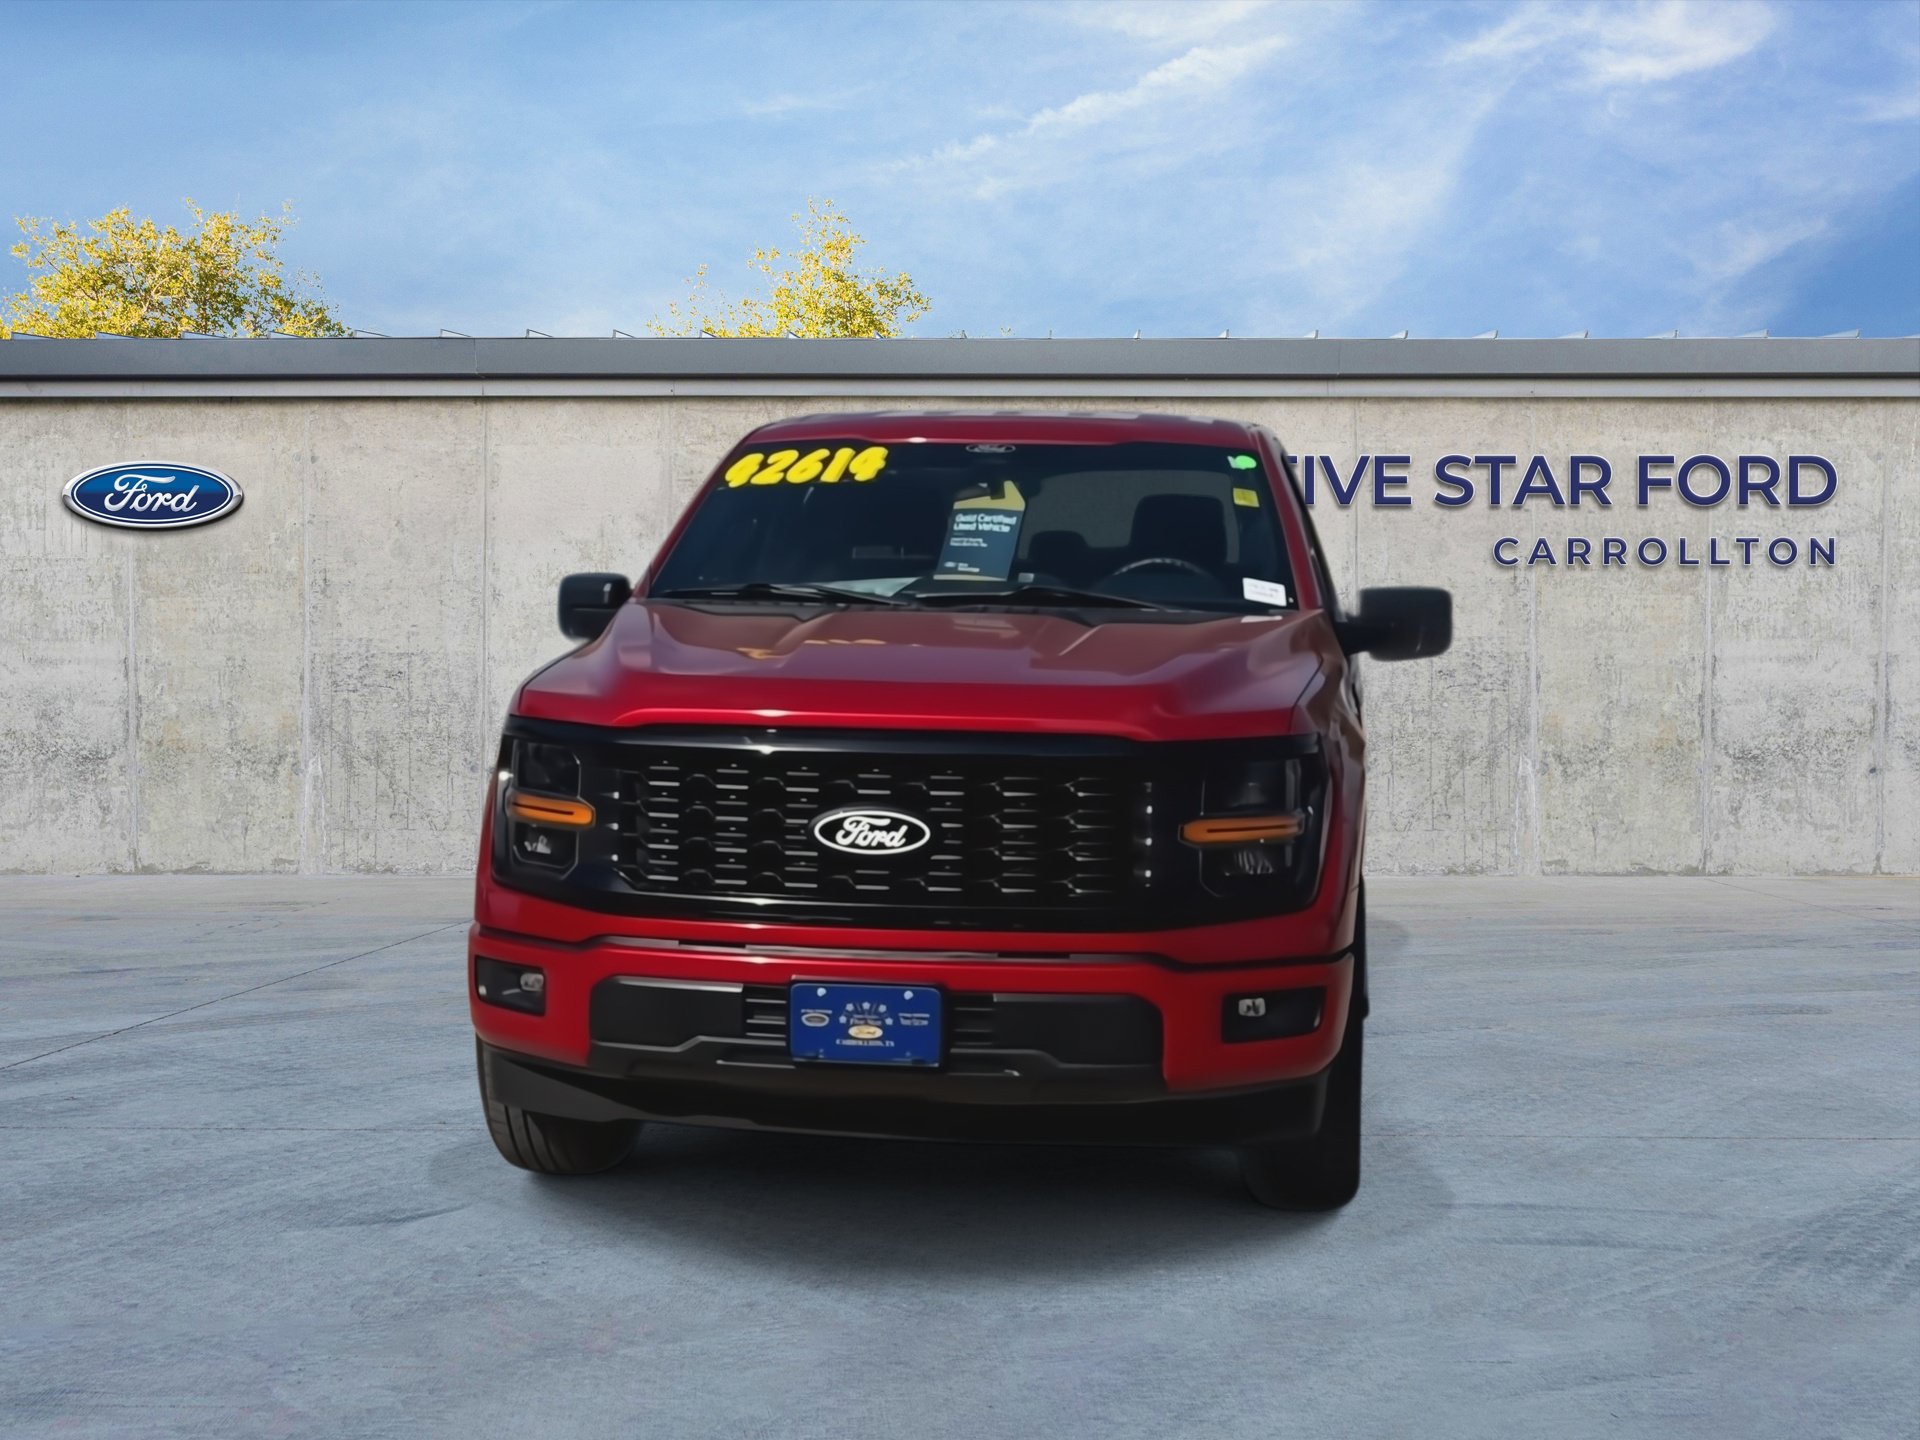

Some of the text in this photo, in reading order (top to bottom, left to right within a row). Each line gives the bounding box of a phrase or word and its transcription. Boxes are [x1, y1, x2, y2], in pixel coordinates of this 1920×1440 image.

[724, 446, 889, 488] 42614
[1287, 454, 1839, 507] IVE STAR FORD
[103, 473, 200, 513] Ford
[953, 522, 1011, 533] Used Vehicle
[978, 513, 1017, 525] Certified
[1492, 536, 1837, 566] CARROLLTON
[835, 816, 909, 848] Ford
